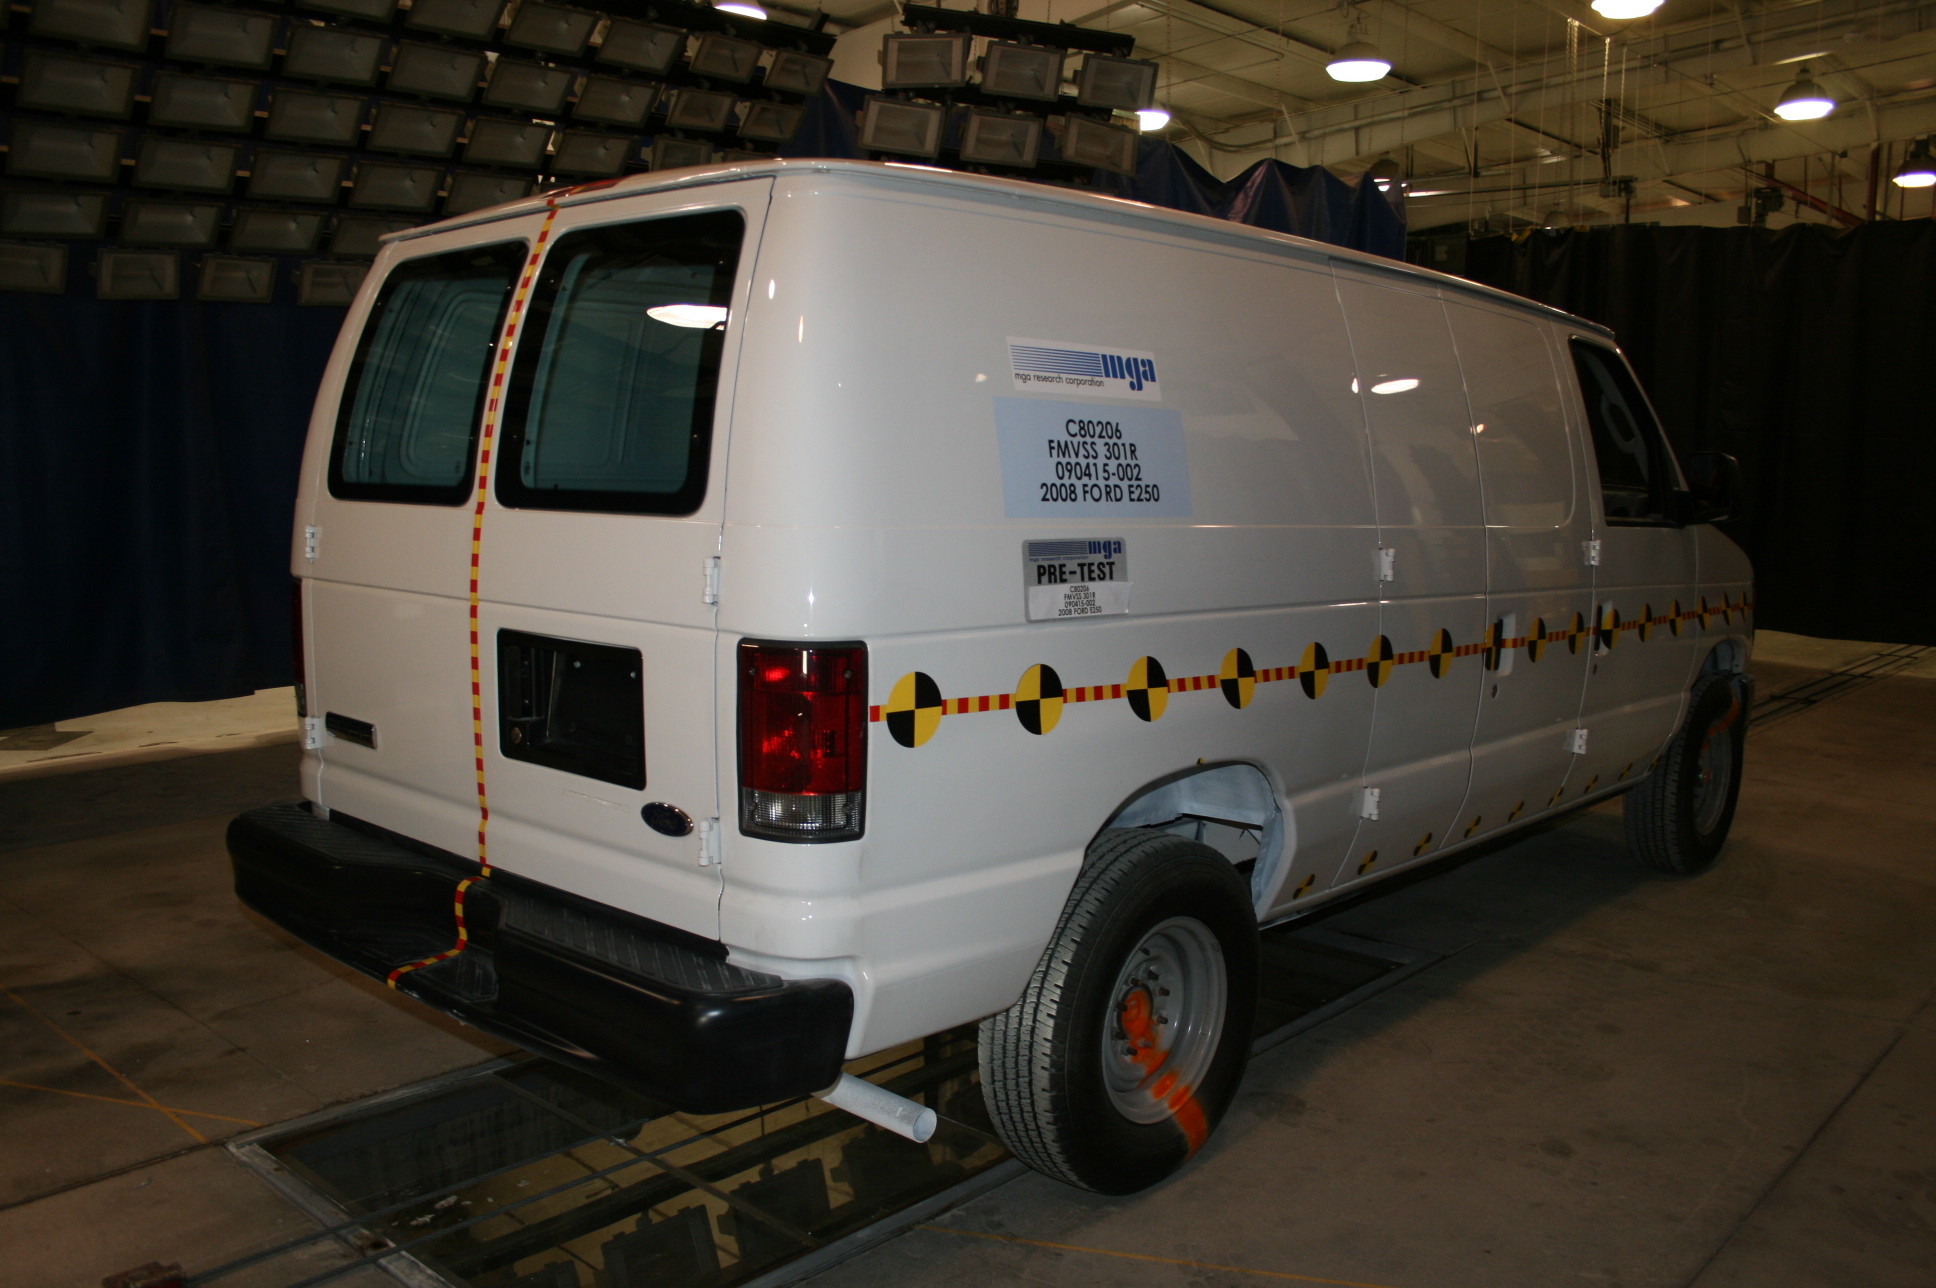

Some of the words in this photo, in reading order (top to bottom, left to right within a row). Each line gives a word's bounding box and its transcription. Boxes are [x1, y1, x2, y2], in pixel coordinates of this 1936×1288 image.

[1014, 372, 1032, 384] mga
[1033, 373, 1064, 384] research
[1065, 376, 1105, 388] corporation
[1100, 353, 1157, 392] mga
[1065, 418, 1122, 440] C80206
[1048, 439, 1098, 460] FMVSS
[1103, 441, 1138, 461] 301R
[1055, 461, 1142, 482] 090415-002
[1040, 482, 1078, 503] 2008
[1082, 483, 1123, 503] FORD
[1128, 484, 1160, 503] E250
[1087, 540, 1122, 560] mga
[1036, 561, 1116, 584] PRE-TEST
[1064, 593, 1082, 601] FMVSS
[1083, 592, 1096, 600] 301R
[1069, 585, 1090, 593] C80206
[1058, 608, 1073, 616] 2008
[1073, 607, 1089, 615] FORD
[1089, 606, 1103, 614] E250
[1064, 600, 1096, 608] 090415-002
